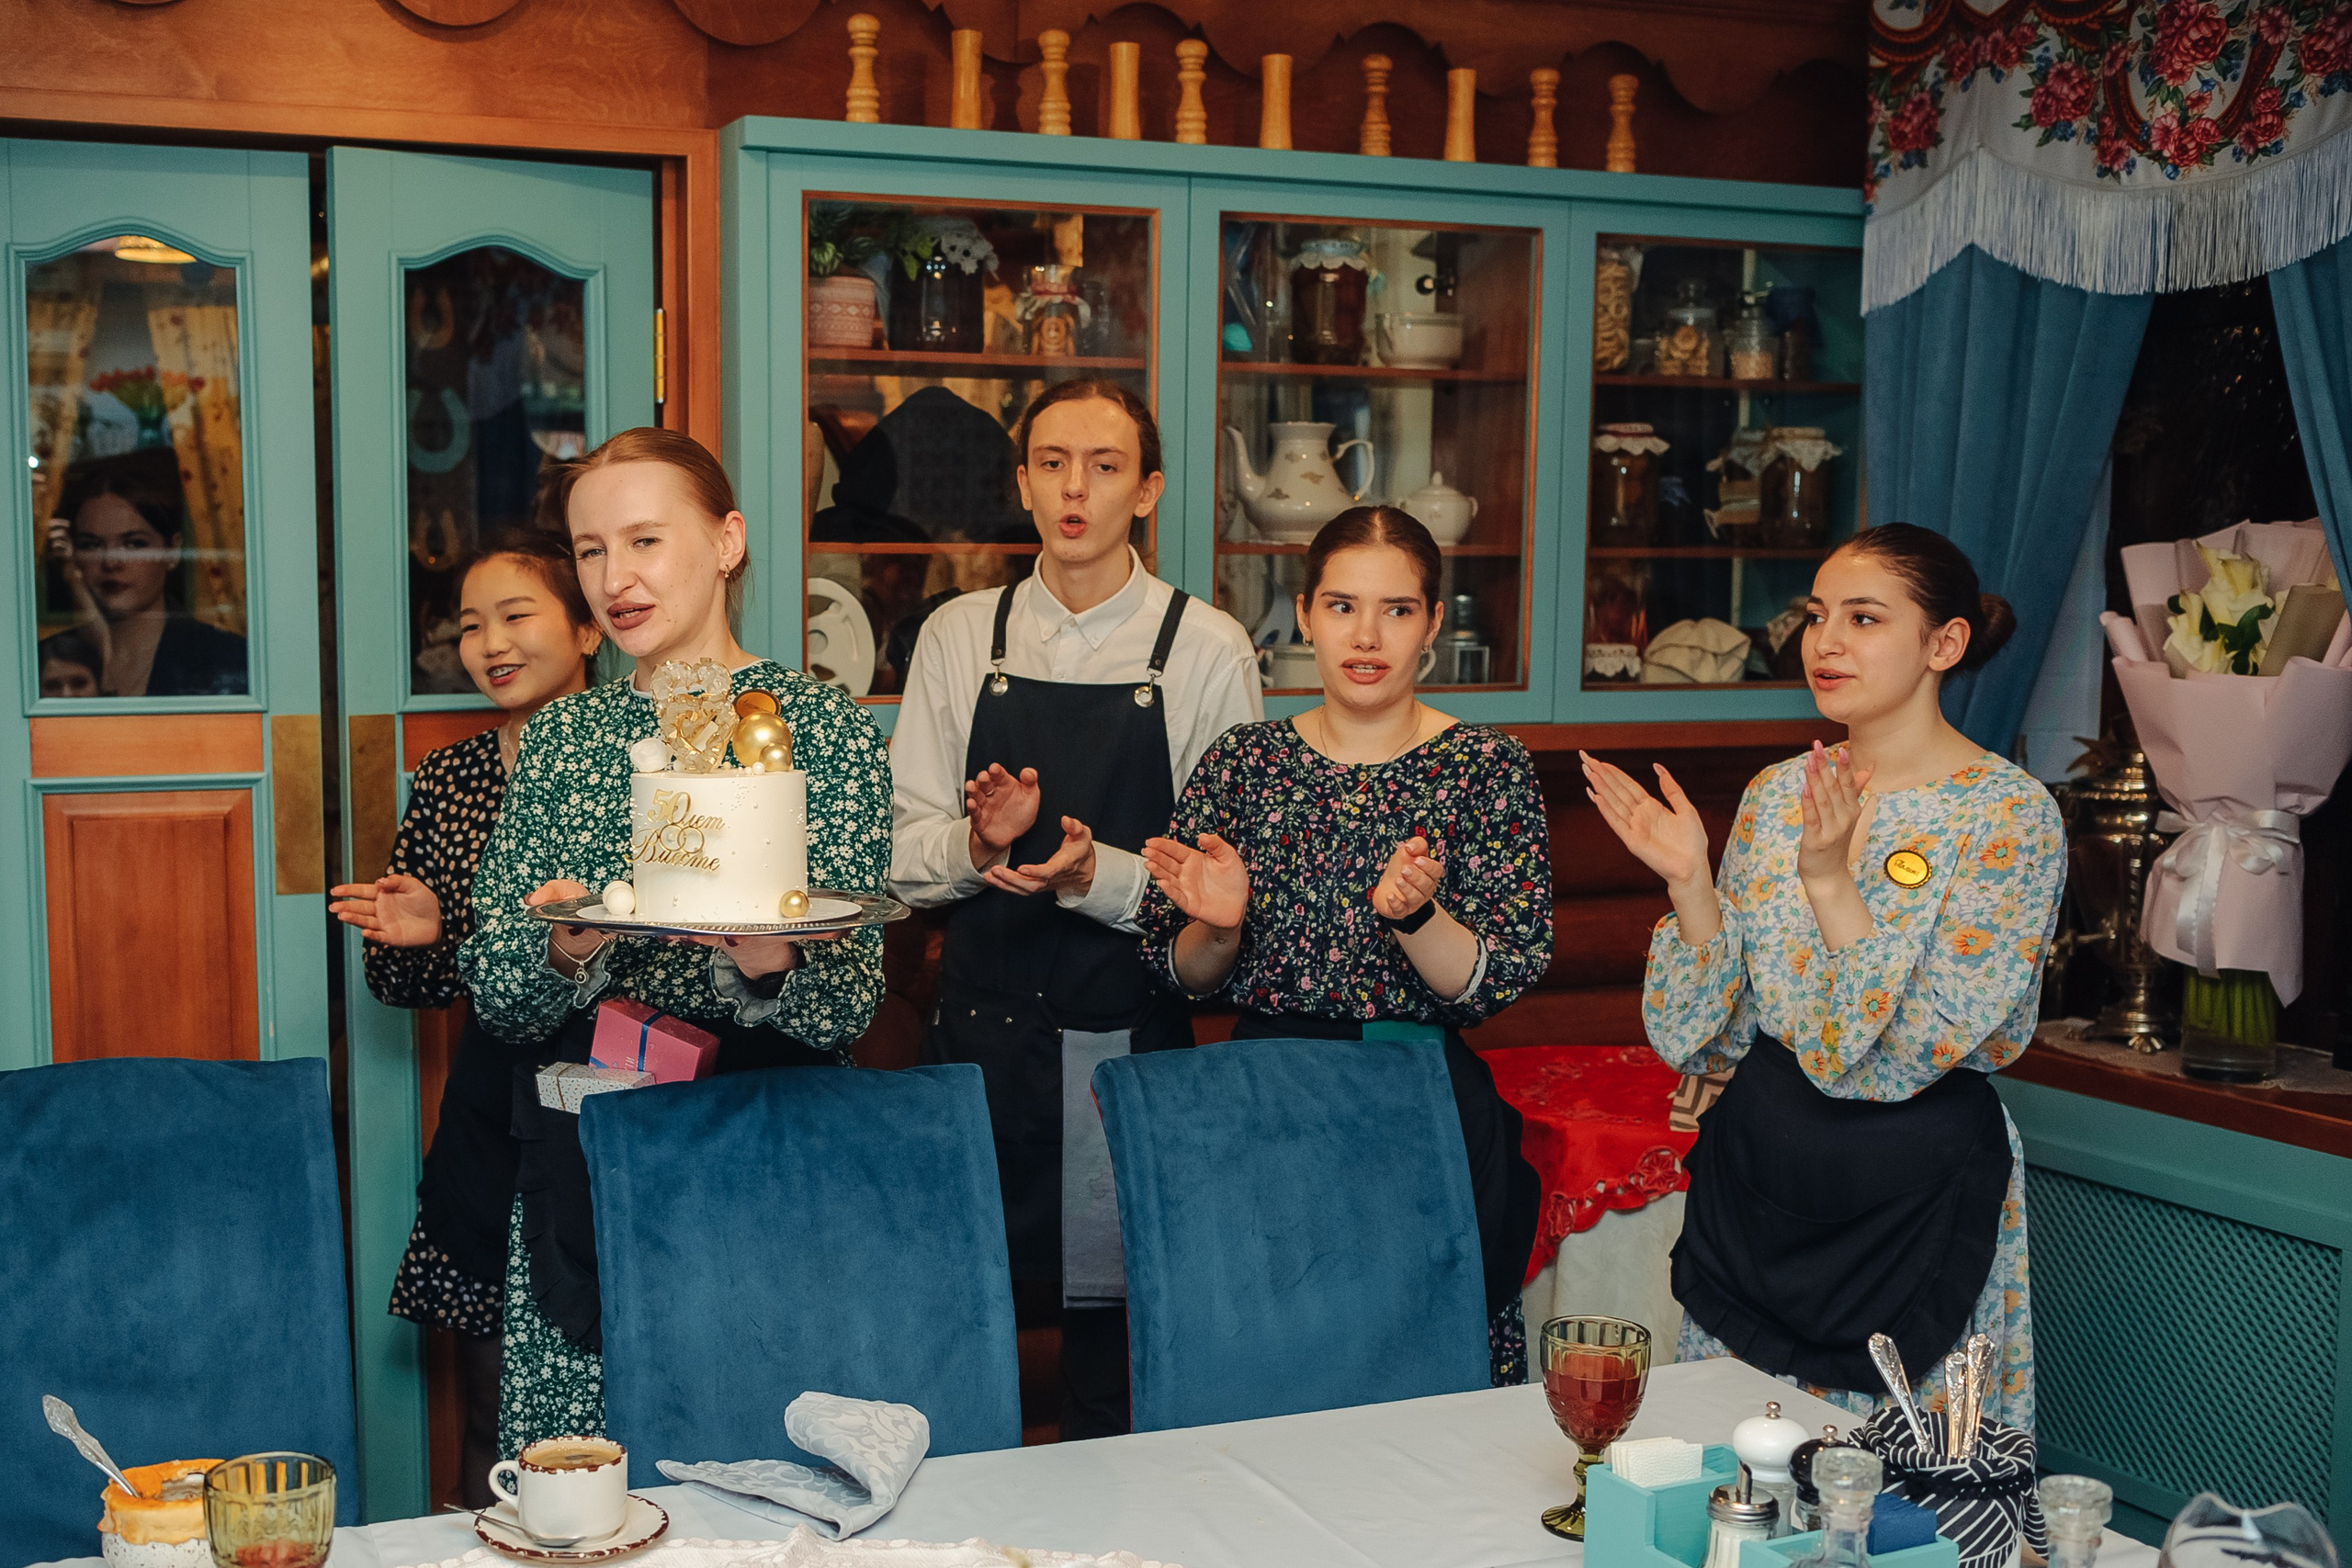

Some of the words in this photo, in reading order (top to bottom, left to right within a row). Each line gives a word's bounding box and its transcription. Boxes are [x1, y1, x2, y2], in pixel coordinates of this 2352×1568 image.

[647, 788, 692, 825] 50
[683, 813, 726, 830] лет
[623, 828, 720, 872] Вместе
